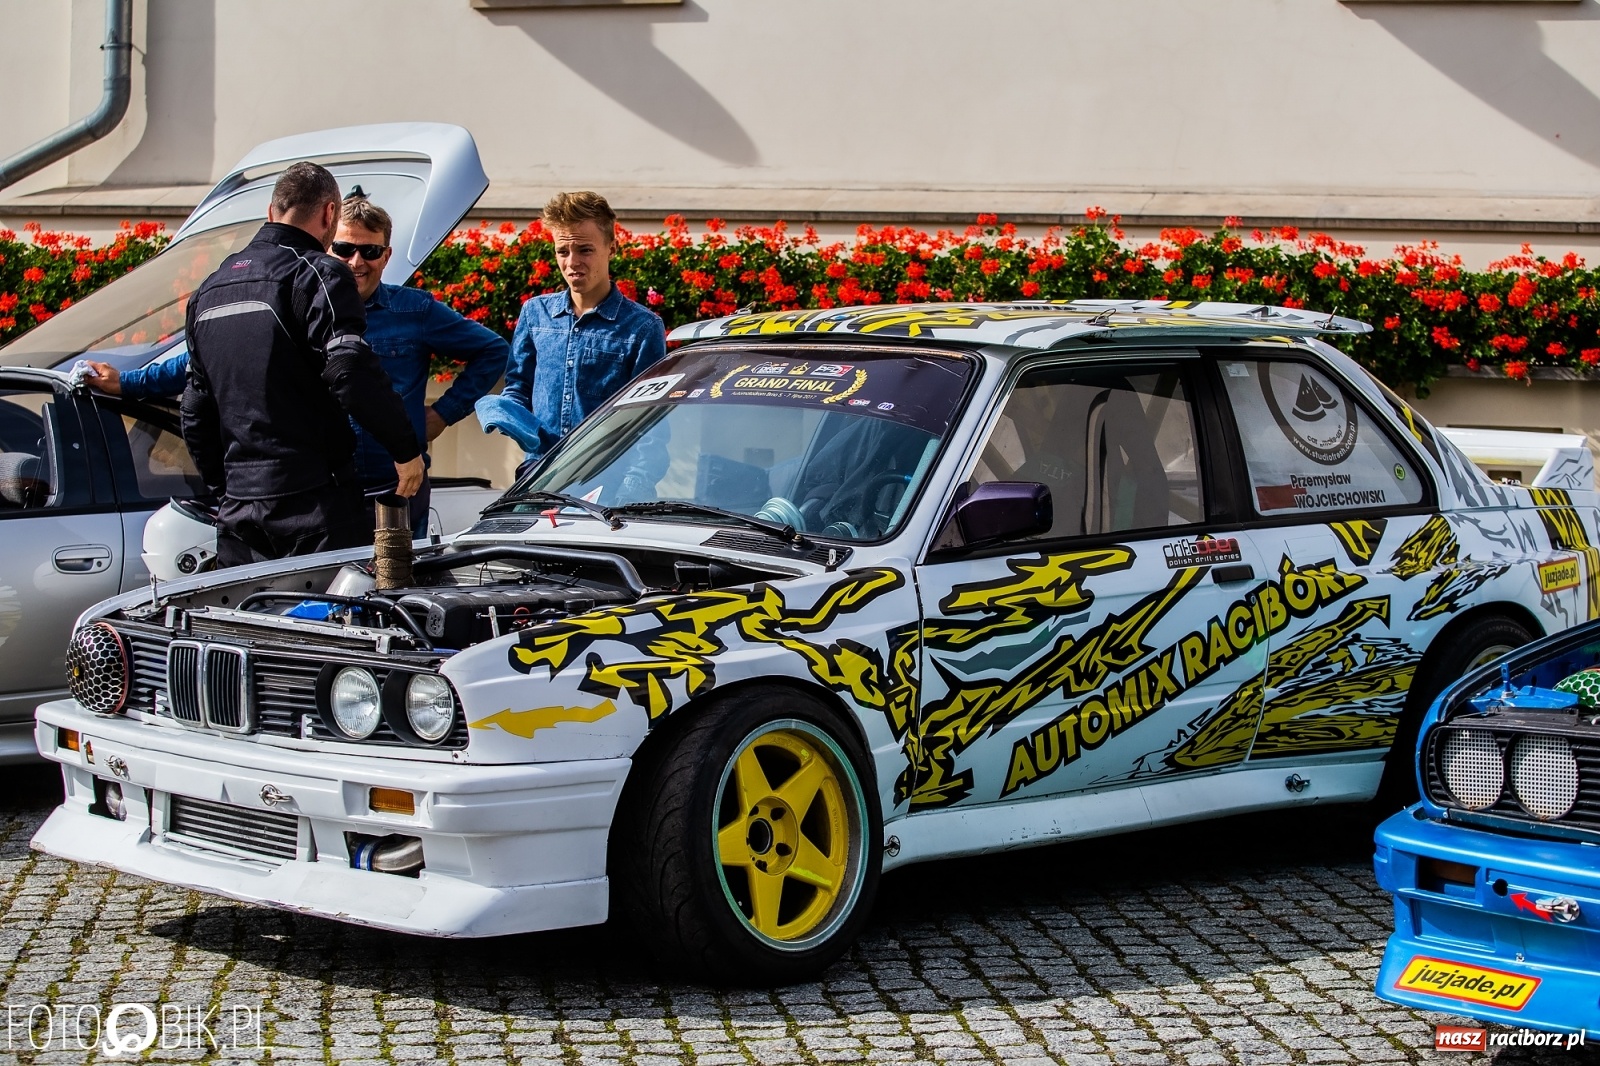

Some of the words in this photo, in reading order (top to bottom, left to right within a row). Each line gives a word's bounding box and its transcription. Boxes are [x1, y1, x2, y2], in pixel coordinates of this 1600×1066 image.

[629, 381, 669, 398] 179
[734, 377, 790, 388] GRAND
[788, 379, 836, 392] FINAL
[1290, 472, 1351, 489] Przemysław
[1295, 490, 1386, 509] WOJCIECHOWSKI
[1168, 558, 1193, 567] polish
[1195, 555, 1213, 563] drift
[1214, 553, 1240, 561] series
[1544, 563, 1577, 589] juzjade.pl
[1002, 650, 1178, 797] AUTOMIX
[1408, 964, 1527, 1000] juzjade.pl
